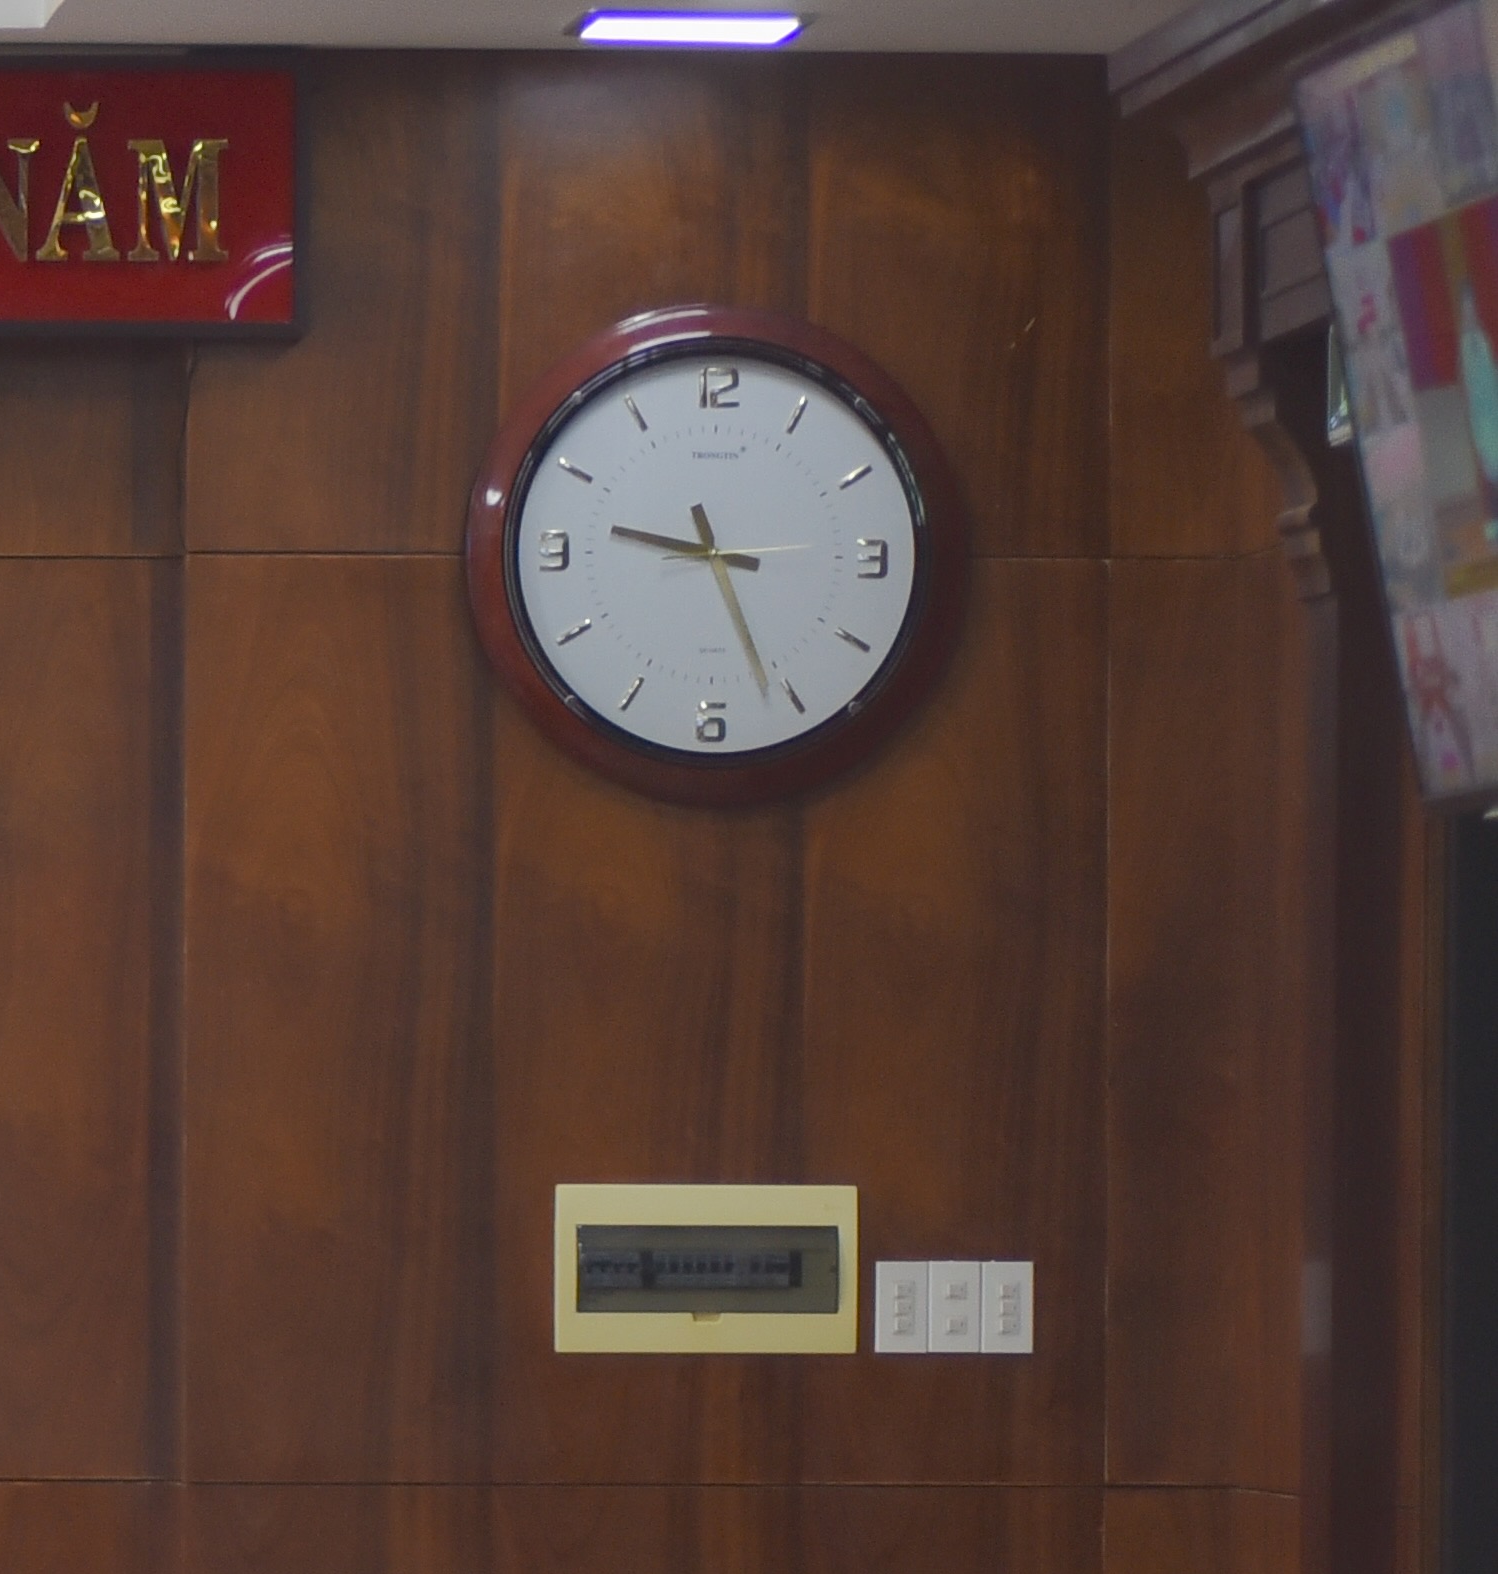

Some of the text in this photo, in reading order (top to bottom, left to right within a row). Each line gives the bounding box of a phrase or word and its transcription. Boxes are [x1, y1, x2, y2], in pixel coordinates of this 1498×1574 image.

[698, 366, 740, 409] 12
[538, 529, 570, 572] 9
[856, 538, 889, 580] 3
[694, 700, 727, 743] 6
